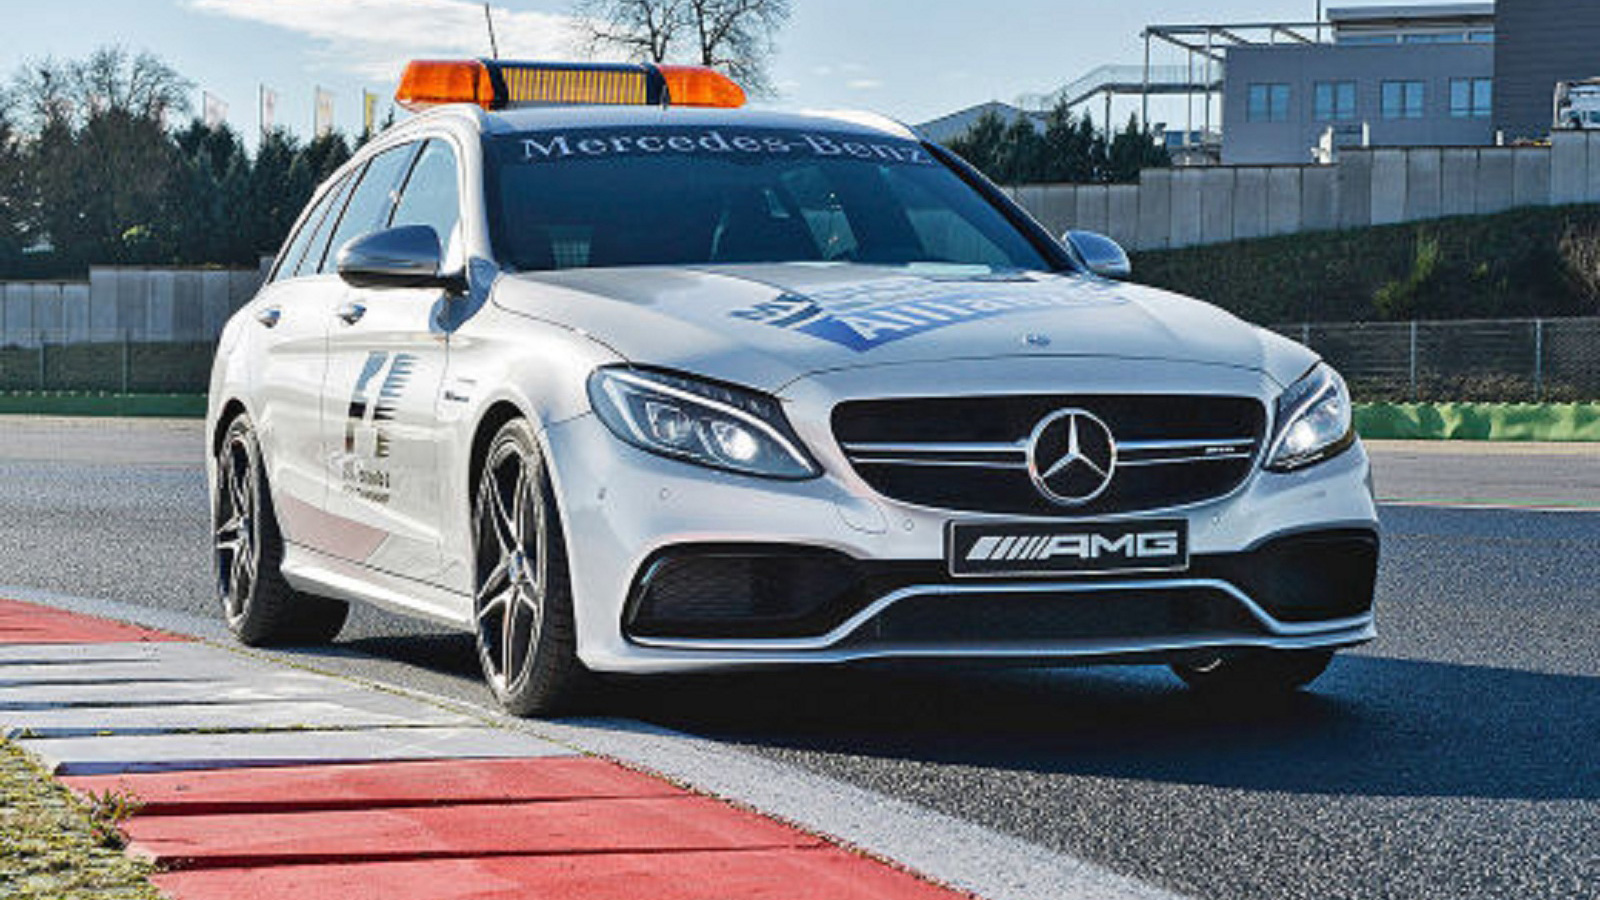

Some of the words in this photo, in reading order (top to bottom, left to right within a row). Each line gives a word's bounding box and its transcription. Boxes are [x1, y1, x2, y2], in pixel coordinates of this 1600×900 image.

[519, 130, 932, 165] Mercedes-Benz
[843, 296, 1085, 340] Allia
[1041, 531, 1178, 558] AMG
